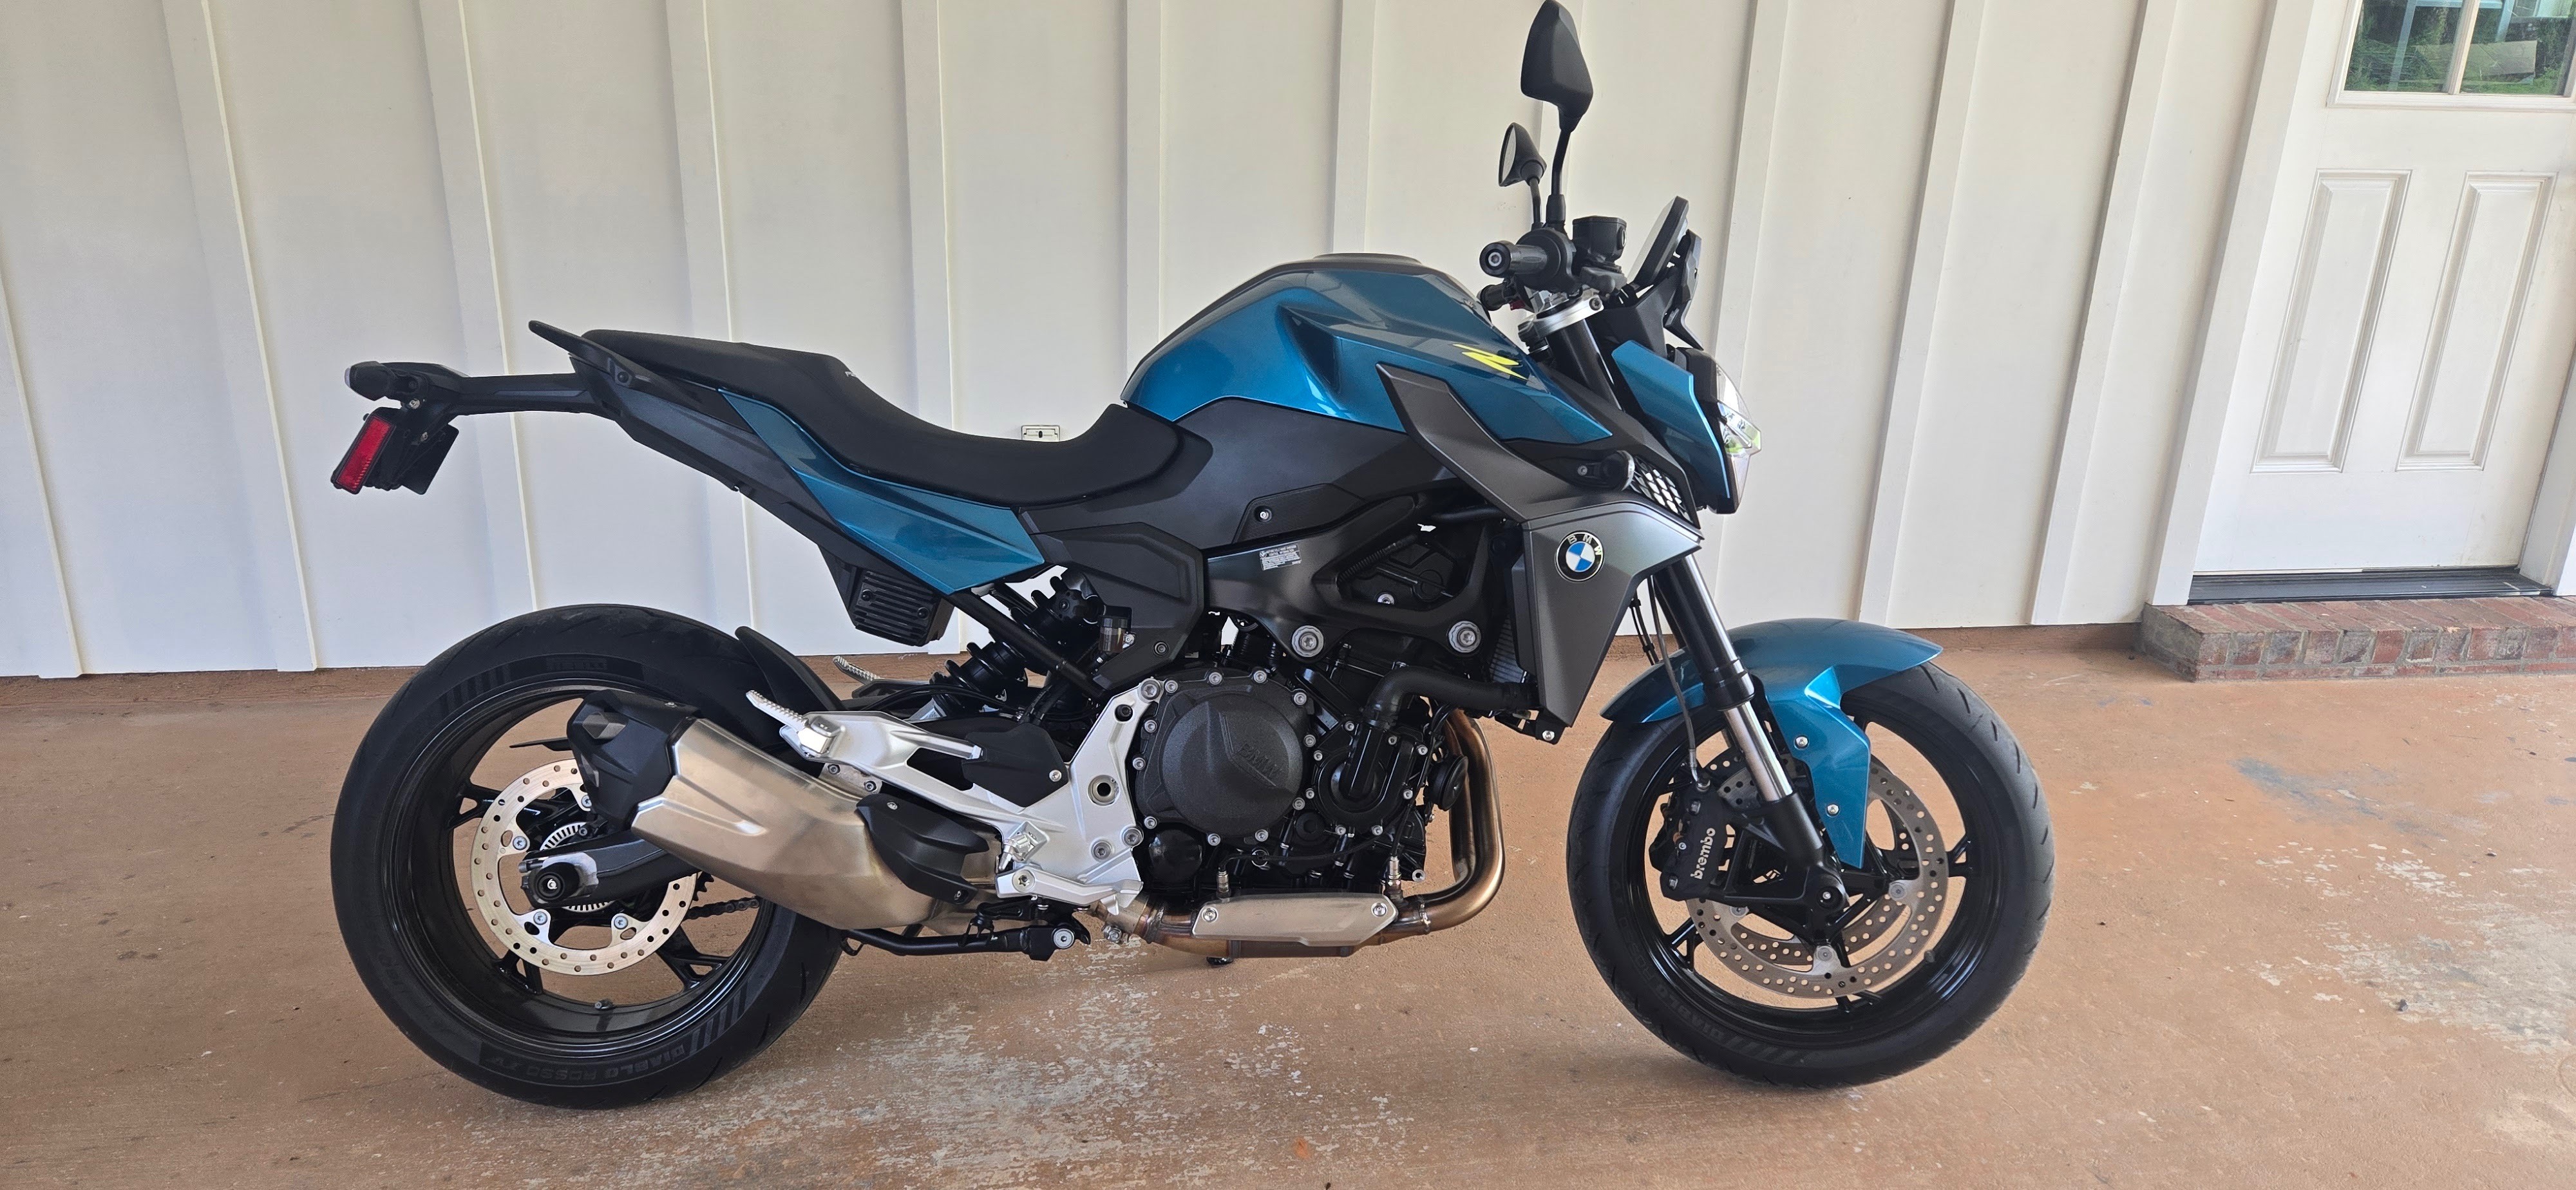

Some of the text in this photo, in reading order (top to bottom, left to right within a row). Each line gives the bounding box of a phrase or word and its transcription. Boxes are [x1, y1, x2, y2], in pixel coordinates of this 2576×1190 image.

[1567, 533, 1602, 556] BMW
[1237, 742, 1282, 777] BMW
[1690, 827, 1716, 880] brembo
[526, 1065, 596, 1080] ROSSO
[604, 1044, 685, 1079] DIABLO
